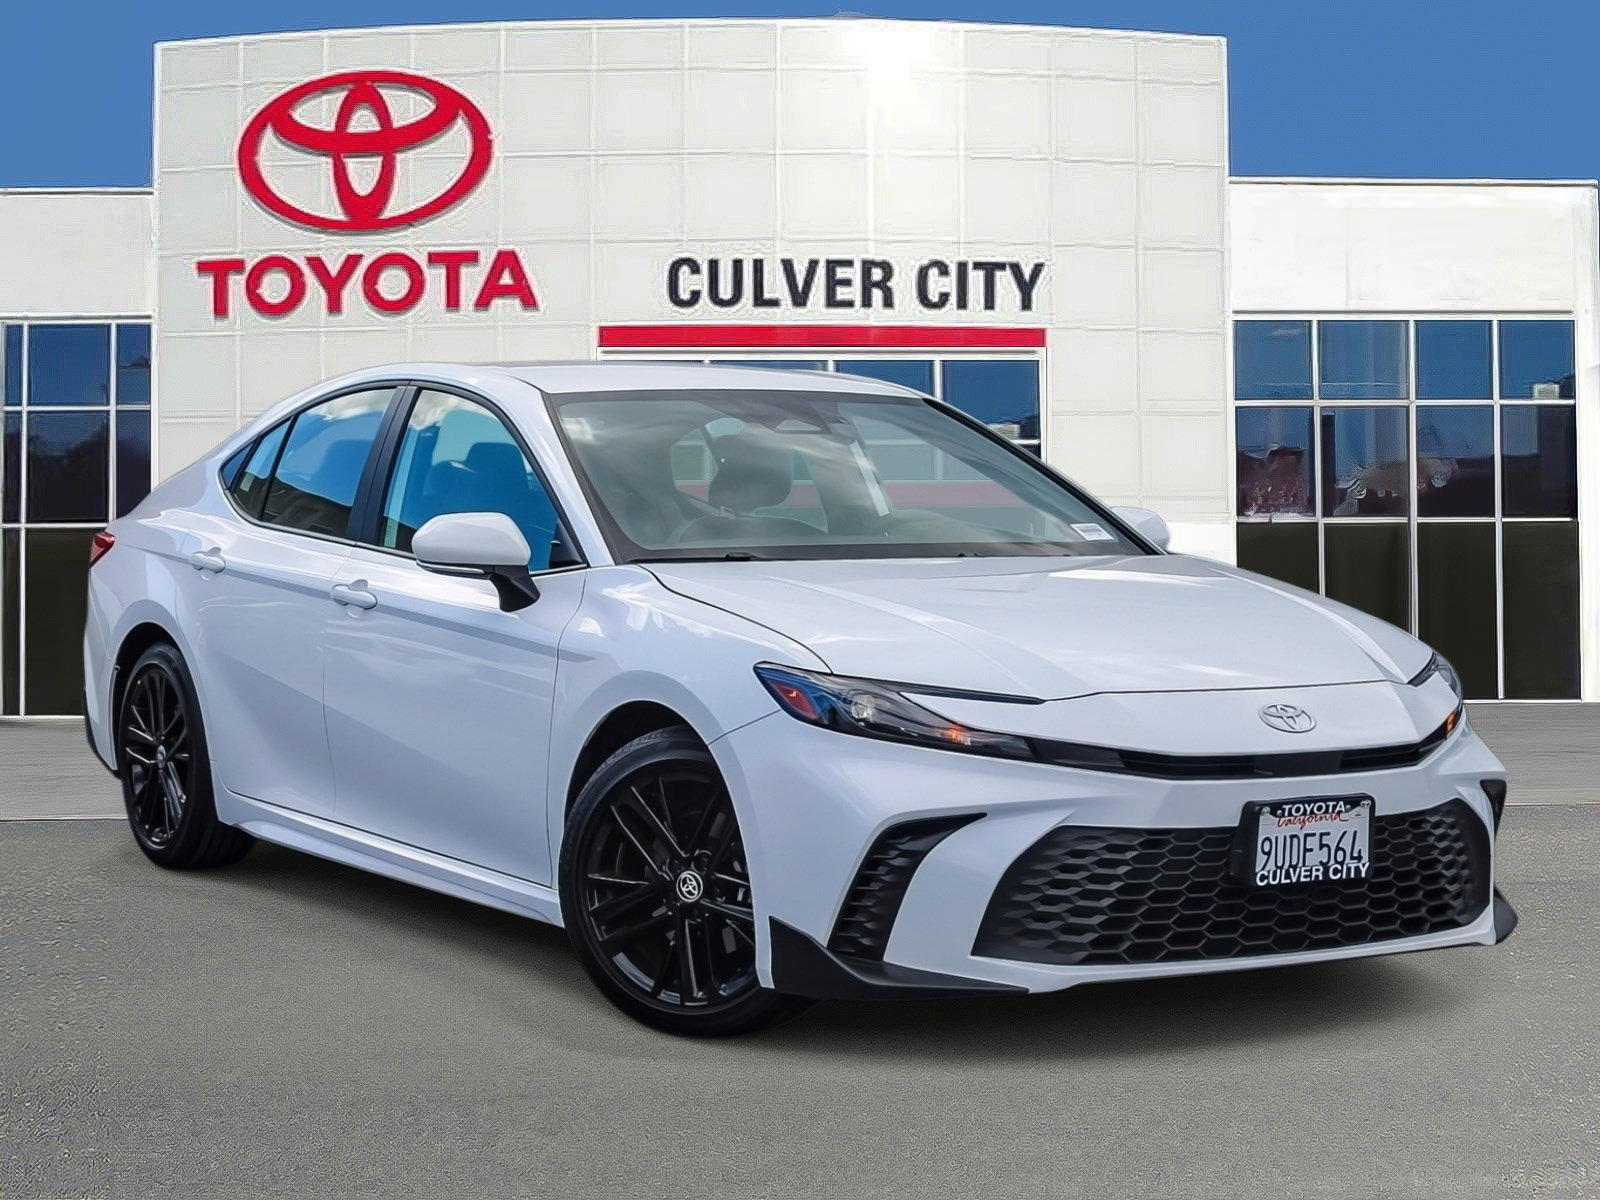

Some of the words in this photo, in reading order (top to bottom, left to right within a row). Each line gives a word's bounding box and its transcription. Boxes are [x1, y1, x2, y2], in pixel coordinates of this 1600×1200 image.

[197, 249, 538, 319] TOYOTA
[667, 257, 895, 310] CULVER
[916, 260, 1045, 311] CITY
[1282, 801, 1346, 817] TOYOTA
[1260, 830, 1364, 871] 9UDF564
[1256, 865, 1324, 886] CULVER
[1329, 862, 1370, 880] CITY
